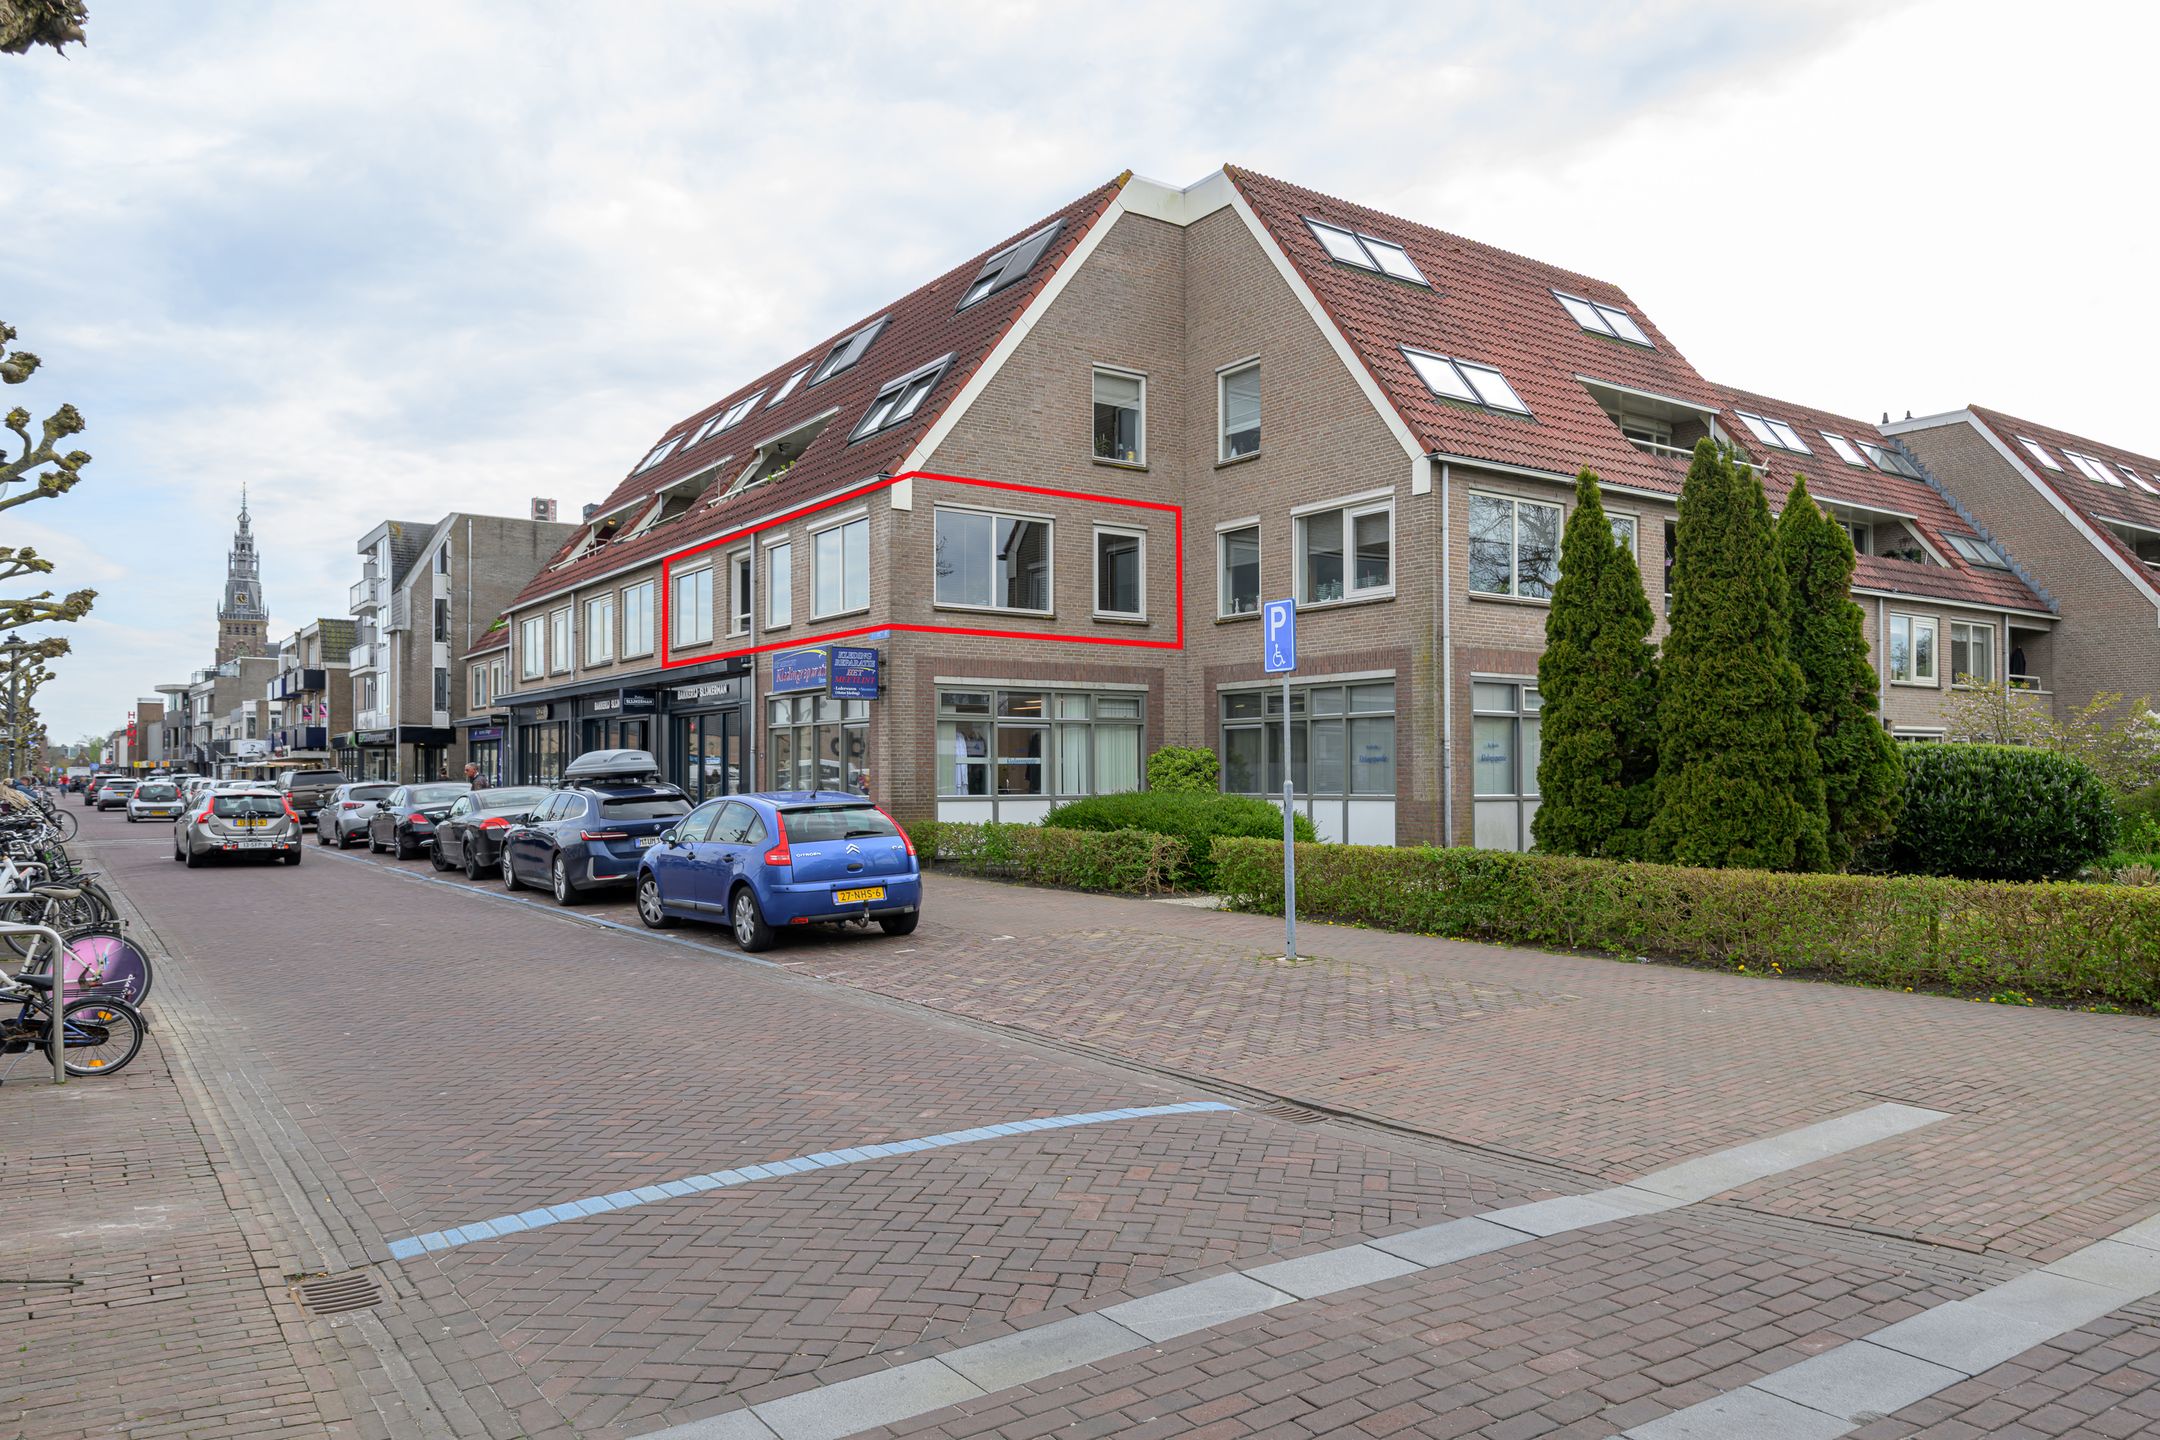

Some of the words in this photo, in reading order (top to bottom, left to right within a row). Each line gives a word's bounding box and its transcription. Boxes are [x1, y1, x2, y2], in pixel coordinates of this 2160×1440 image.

[1270, 606, 1287, 641] P
[838, 651, 872, 659] KLEDING
[834, 659, 875, 667] REPARATIE
[846, 668, 864, 677] HET
[840, 888, 881, 901] 27-NHS-6
